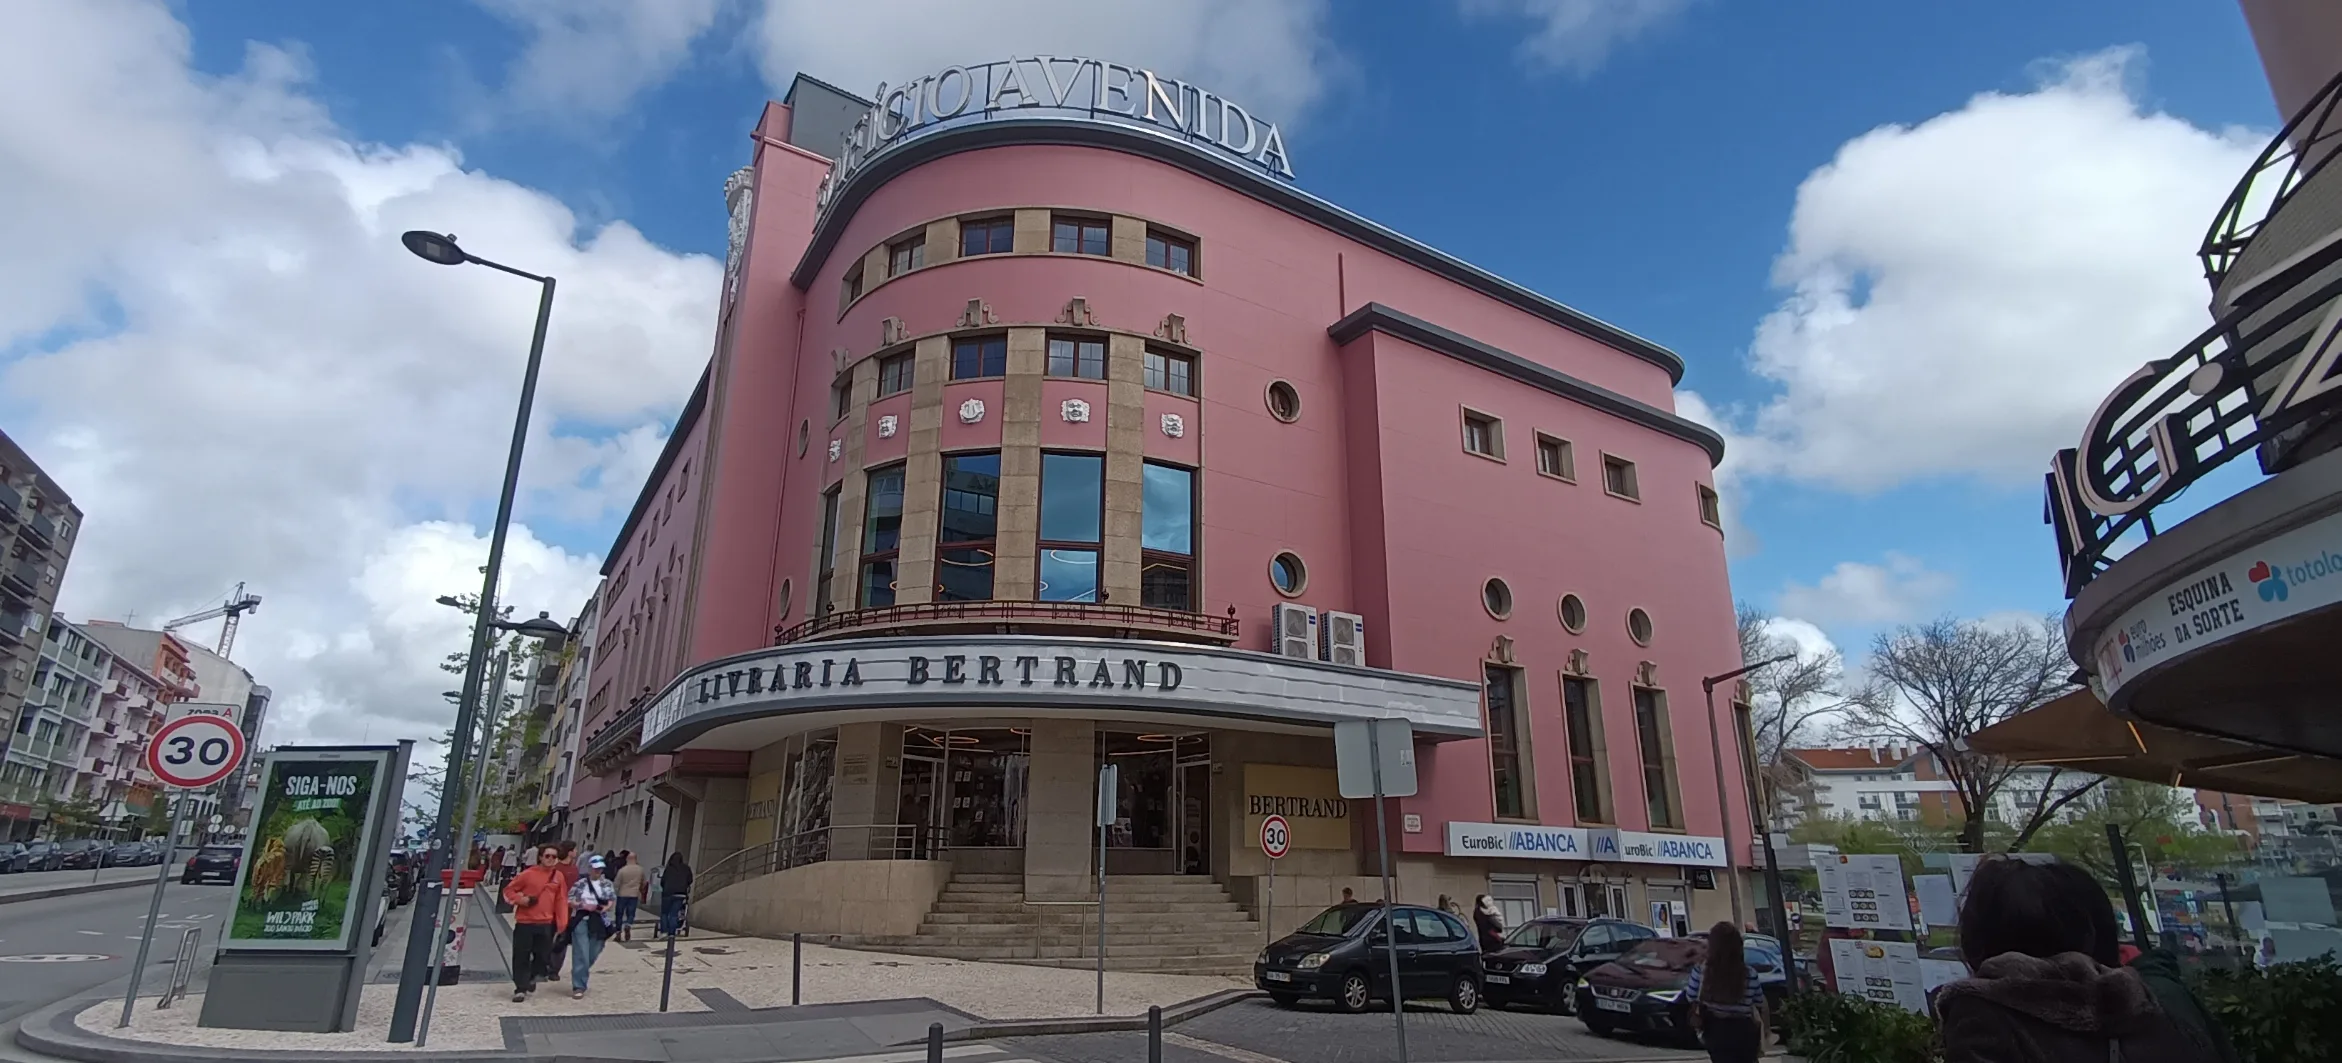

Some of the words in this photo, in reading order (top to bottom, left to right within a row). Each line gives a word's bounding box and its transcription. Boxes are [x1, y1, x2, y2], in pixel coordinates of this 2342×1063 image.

[985, 54, 1296, 181] AVENIDA
[2167, 571, 2234, 617] ESQUINA
[2174, 623, 2192, 644] DA
[2192, 599, 2245, 636] SORTE
[699, 657, 864, 703] LIVRARIA
[907, 655, 1183, 691] BERTRAND
[222, 707, 233, 717] A
[165, 736, 230, 766] 30
[285, 775, 358, 796] SIGA-NOS
[1249, 795, 1347, 818] BERTRAND
[1267, 828, 1286, 845] 30
[1461, 835, 1504, 850] EuroBic
[1624, 843, 1653, 857] uroBic
